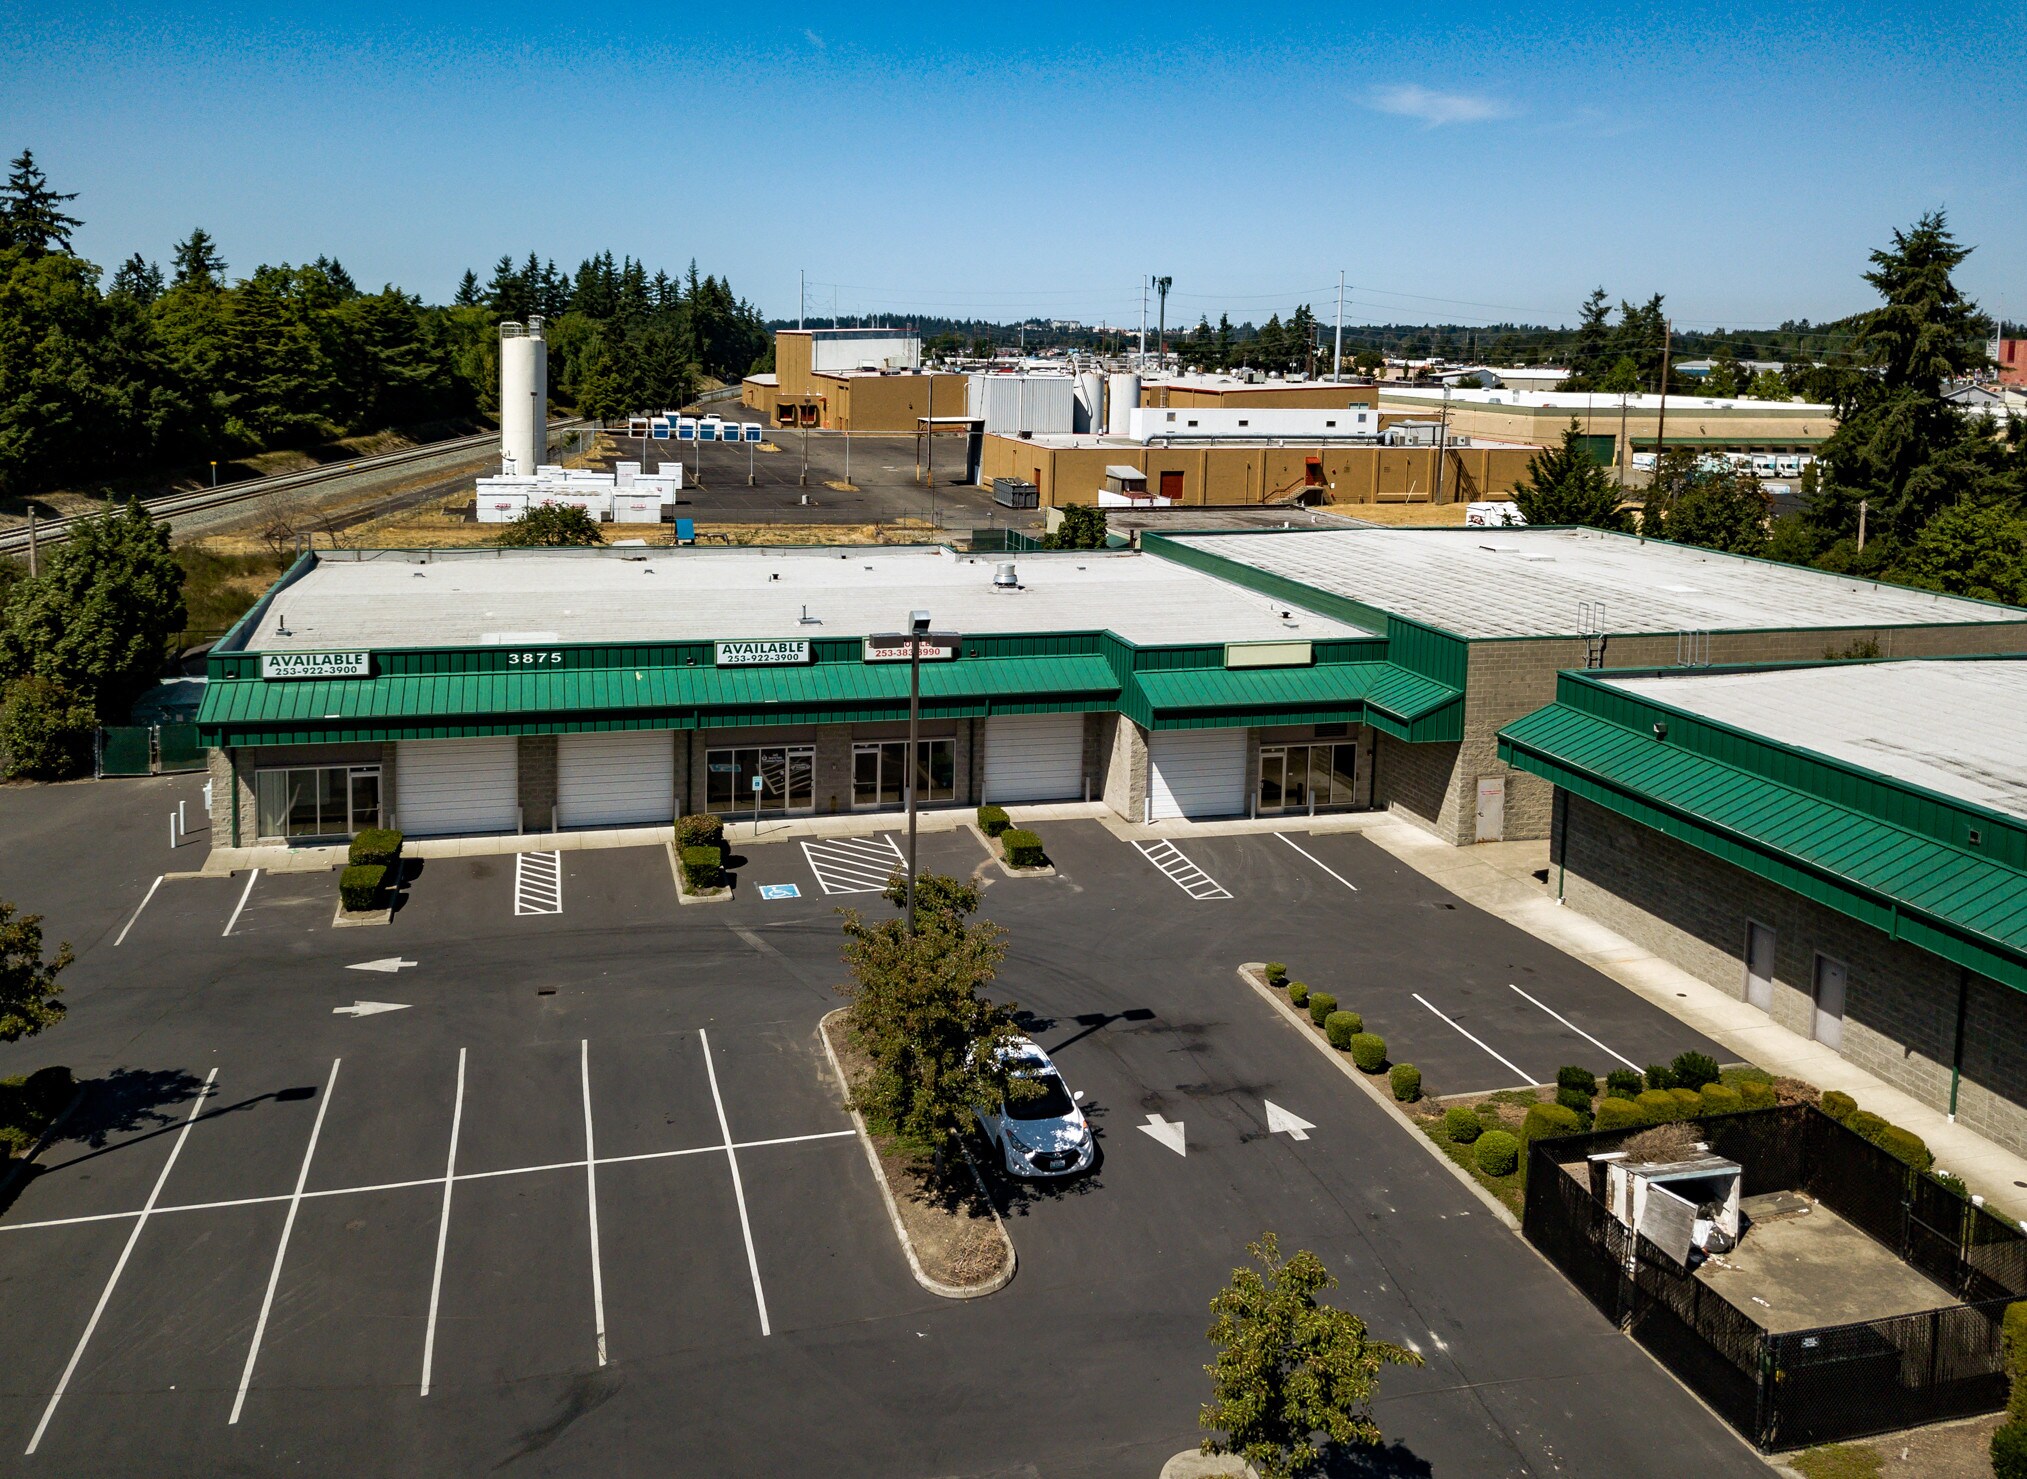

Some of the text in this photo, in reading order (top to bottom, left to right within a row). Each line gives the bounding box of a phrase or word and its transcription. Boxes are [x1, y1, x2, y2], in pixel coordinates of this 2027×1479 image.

[722, 642, 804, 655] AVAILABLE
[269, 654, 363, 667] AVAILABLE
[508, 652, 562, 664] 3875
[727, 653, 799, 663] 253-922-3900
[275, 666, 357, 676] 253-922-3900
